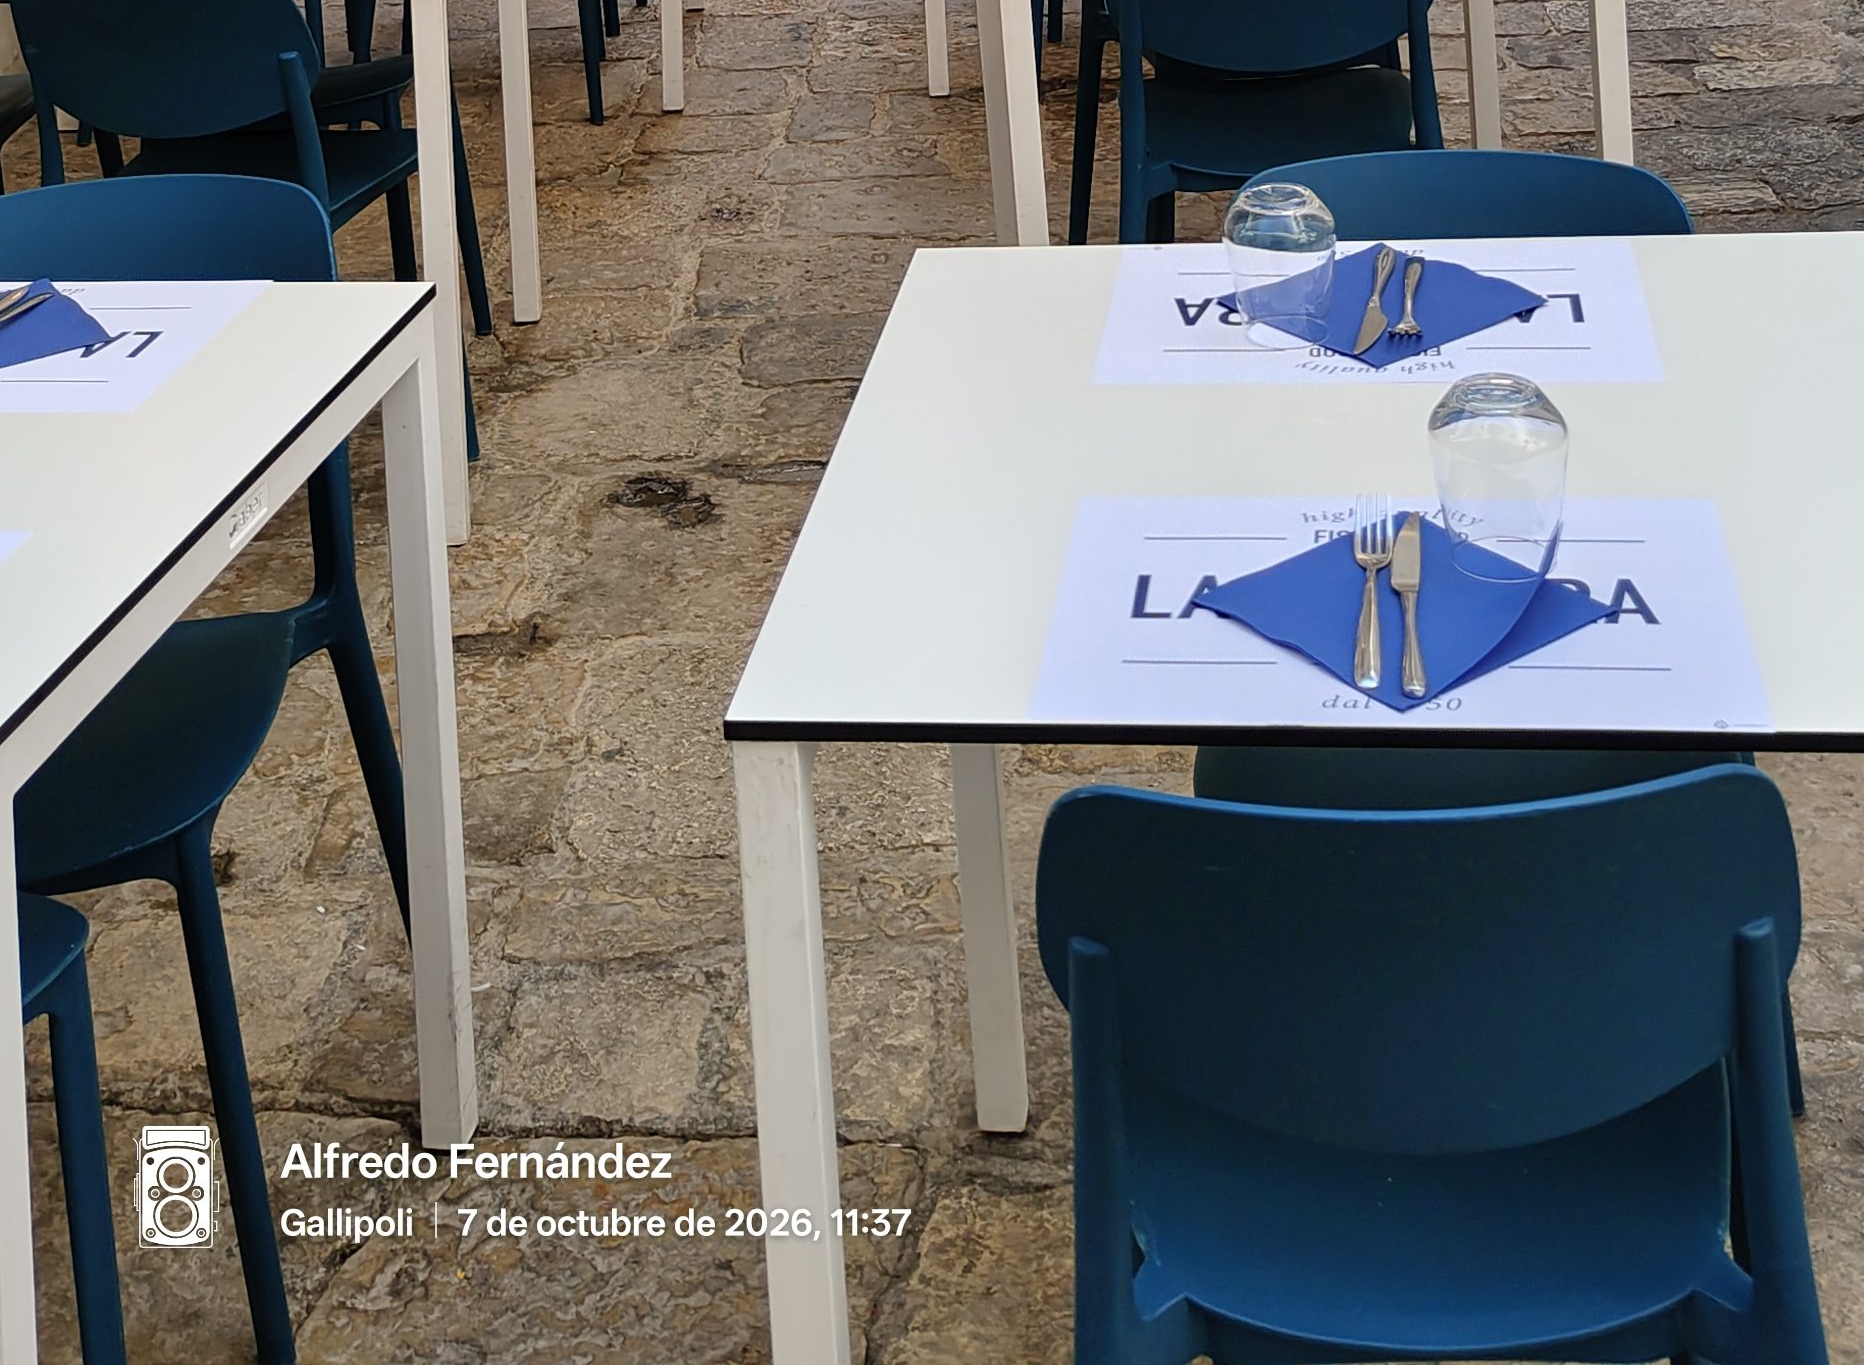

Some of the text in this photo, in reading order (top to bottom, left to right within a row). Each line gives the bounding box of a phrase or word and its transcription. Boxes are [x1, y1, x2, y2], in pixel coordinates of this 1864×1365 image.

[1295, 359, 1455, 375] high quality
[1321, 694, 1372, 711] dal
